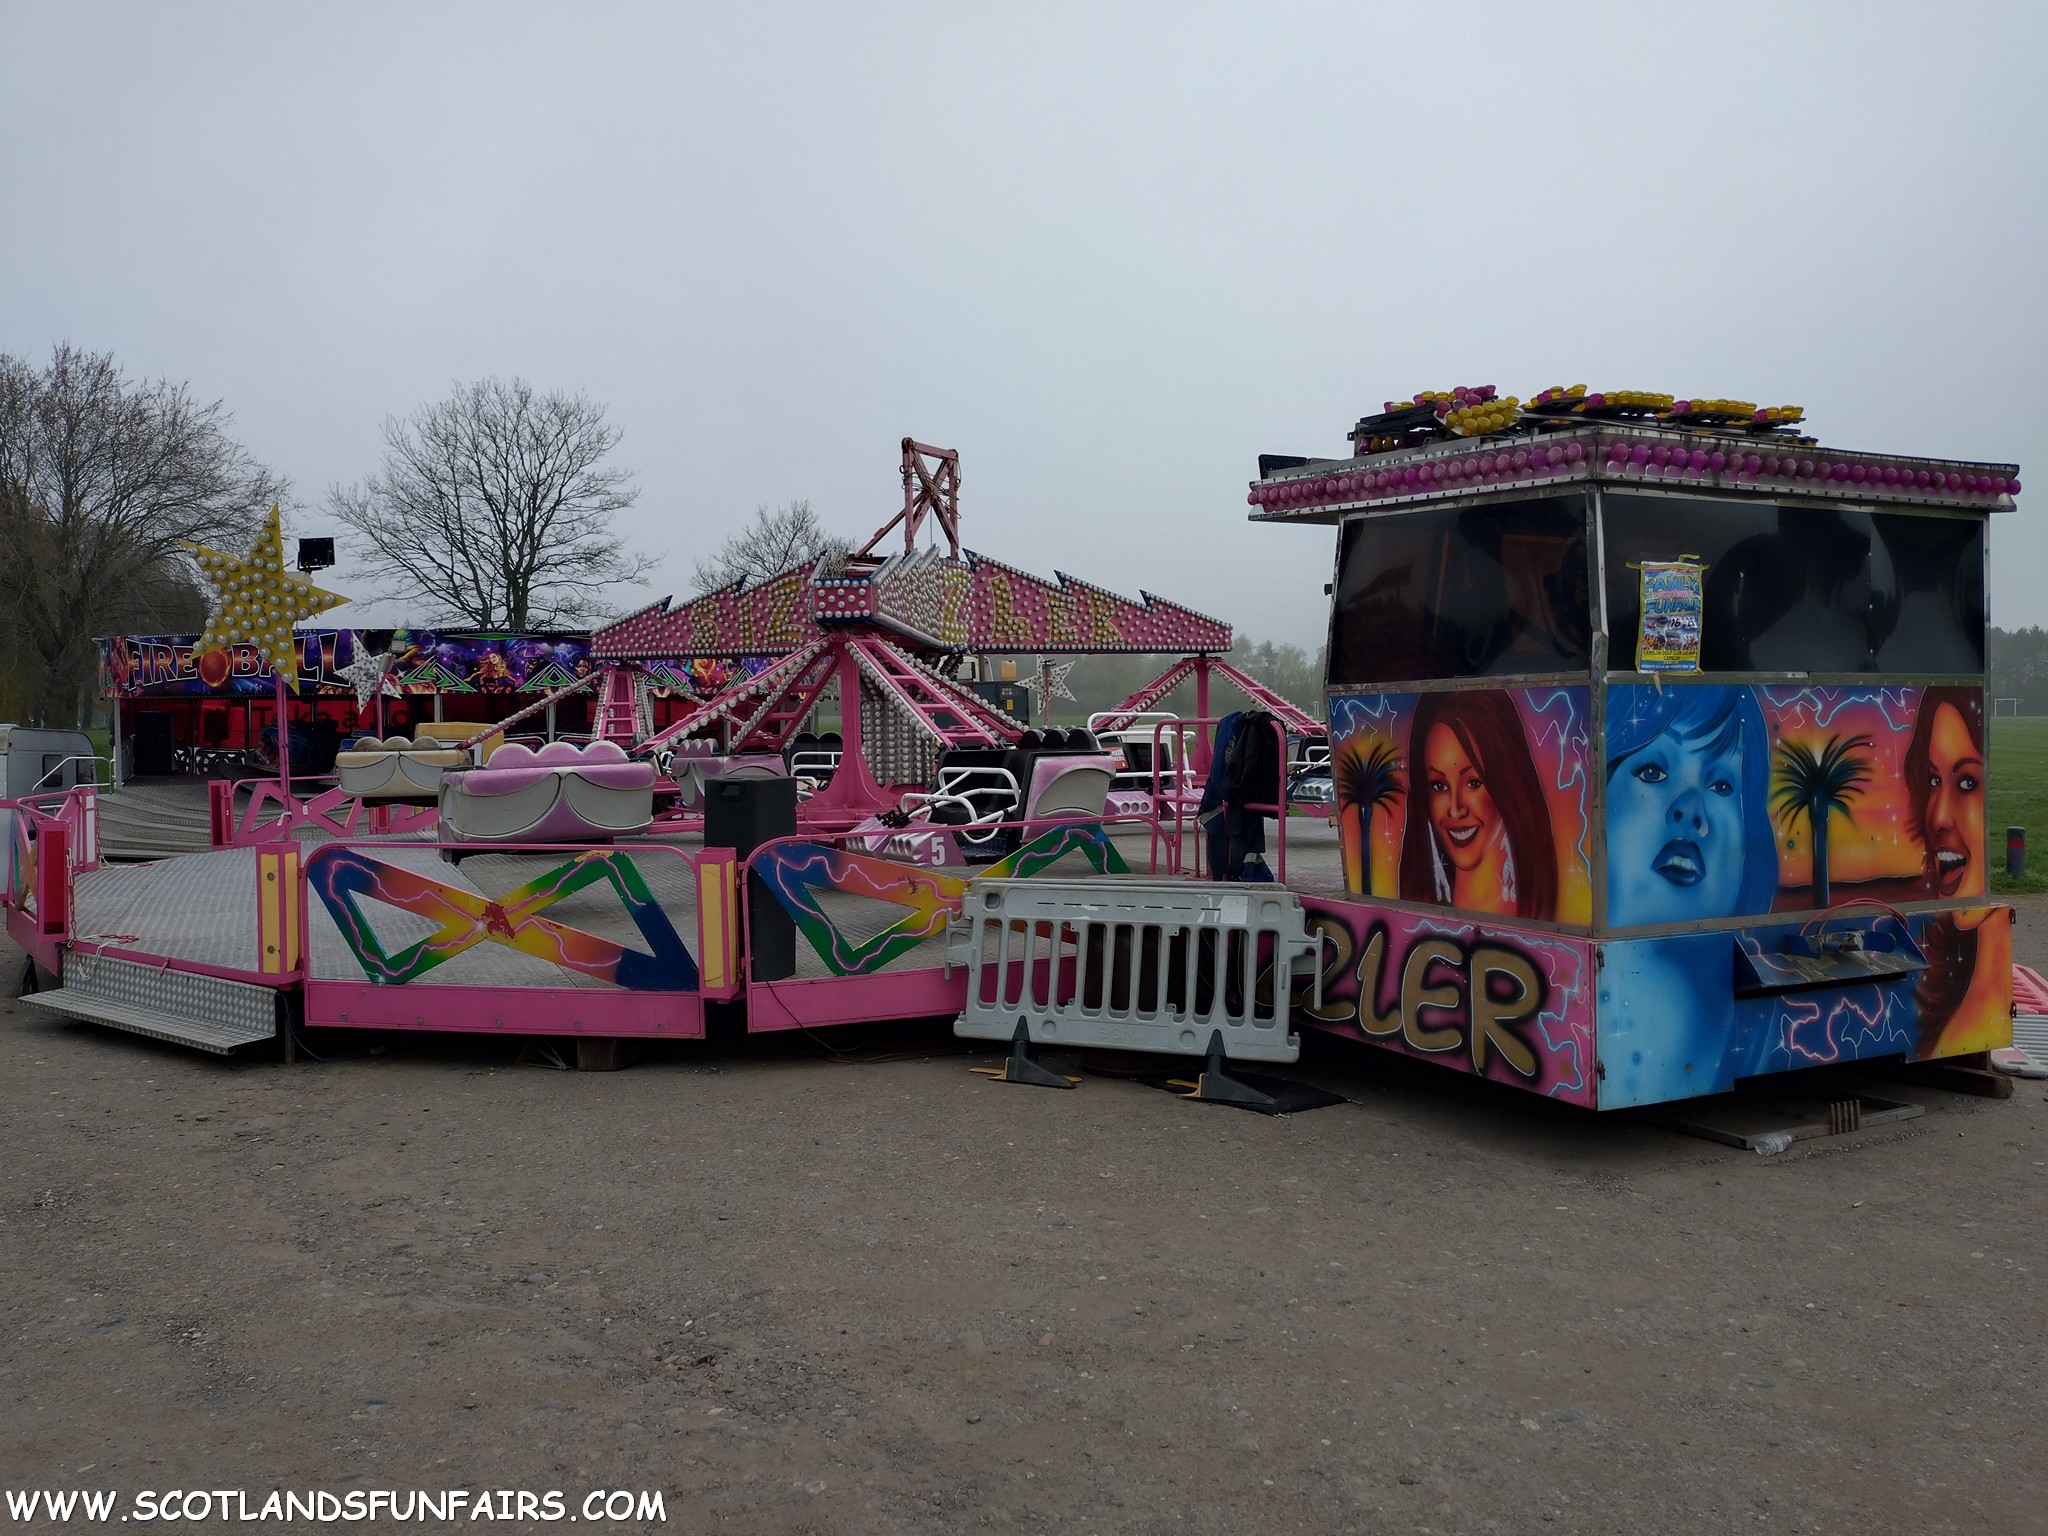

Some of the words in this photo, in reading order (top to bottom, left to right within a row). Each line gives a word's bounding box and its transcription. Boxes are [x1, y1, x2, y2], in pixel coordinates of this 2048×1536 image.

[1644, 574, 1698, 593] FAMILY
[1670, 618, 1681, 628] 16
[125, 638, 198, 691] FIRE
[931, 836, 946, 866] 5
[1228, 917, 1536, 1077] ZLER
